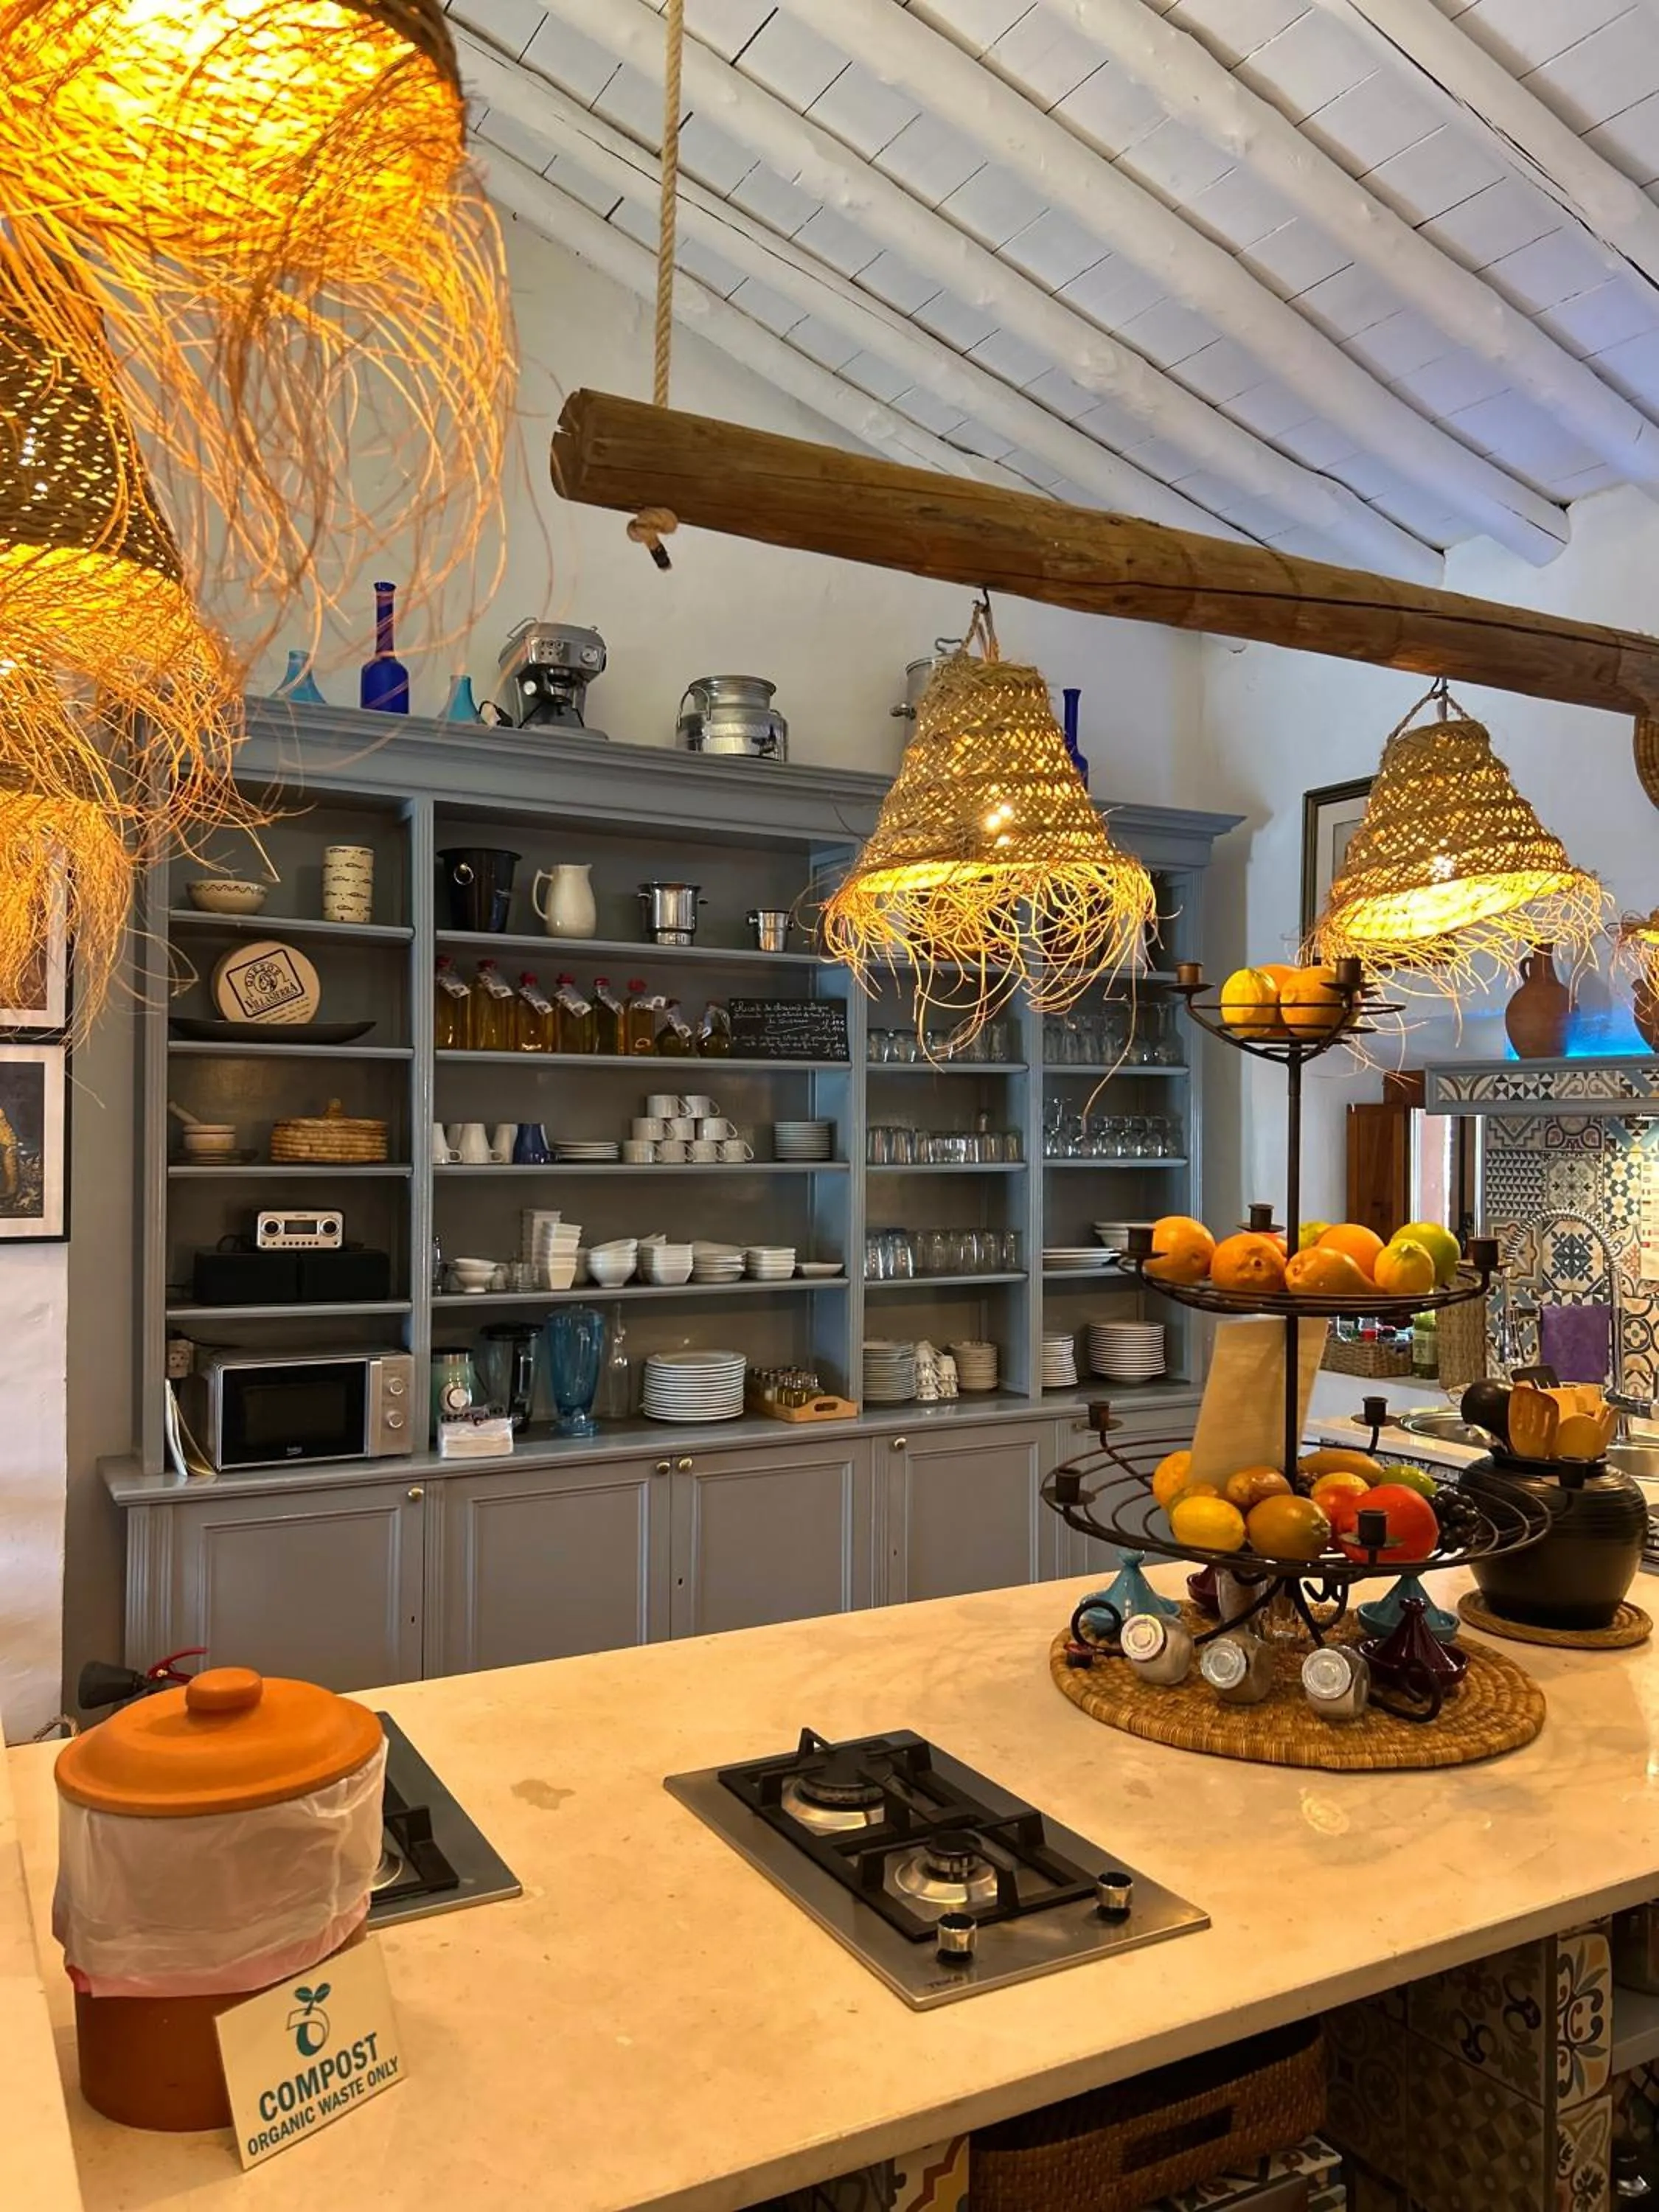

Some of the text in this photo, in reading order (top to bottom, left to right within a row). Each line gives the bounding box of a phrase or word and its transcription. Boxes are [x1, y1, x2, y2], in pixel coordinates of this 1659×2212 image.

[247, 2056, 398, 2156] ORGANIC WASTE ONLY
[259, 2032, 378, 2121] COMPOST
